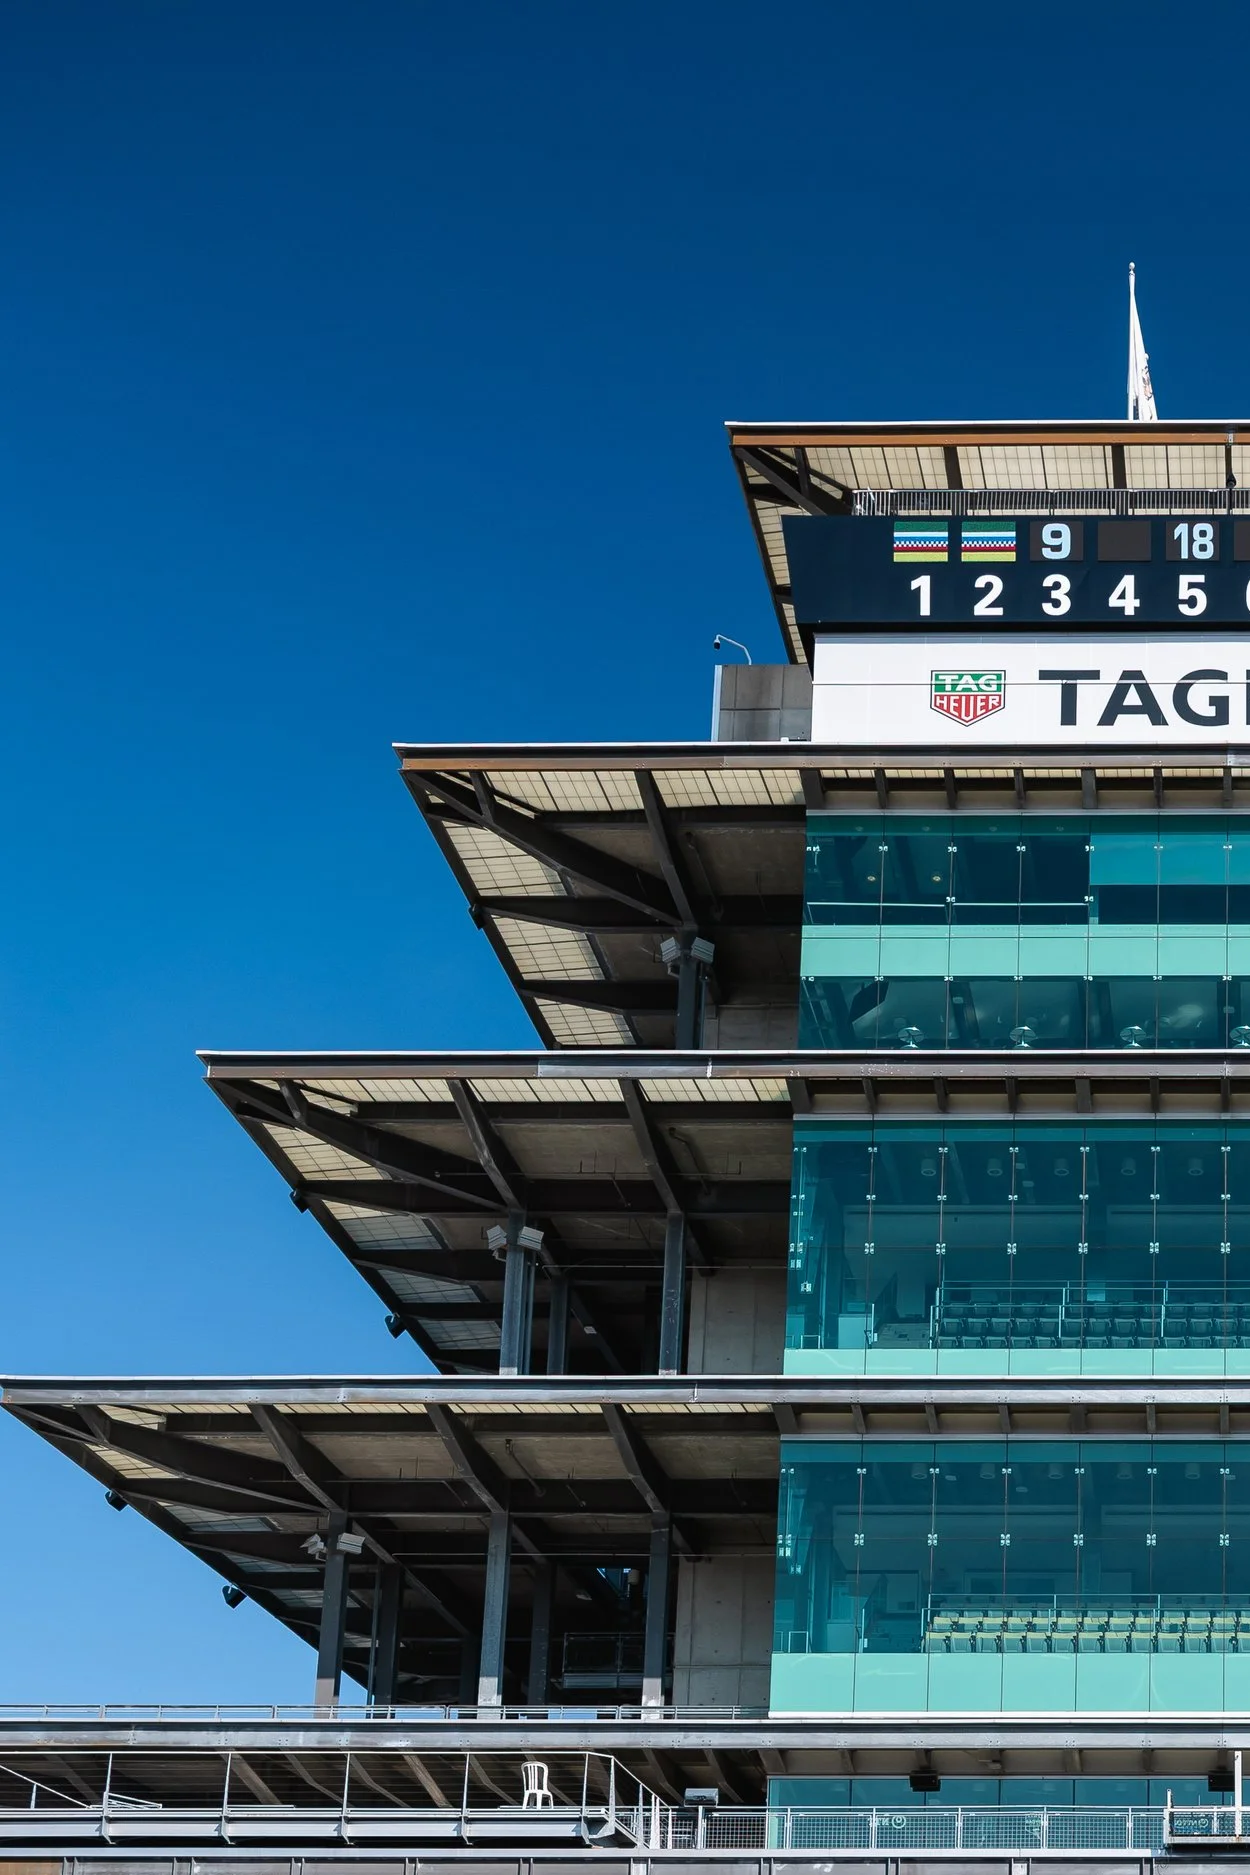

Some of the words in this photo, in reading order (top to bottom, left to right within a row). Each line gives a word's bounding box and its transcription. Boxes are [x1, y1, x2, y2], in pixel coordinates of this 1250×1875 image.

[1041, 523, 1071, 559] 9
[1173, 523, 1214, 559] 18
[910, 575, 932, 616] 1
[973, 574, 1004, 616] 2
[1042, 574, 1072, 616] 3
[1108, 574, 1140, 616] 4
[1177, 574, 1208, 616] 5
[938, 675, 998, 692] TAG
[936, 695, 1000, 722] HEUER
